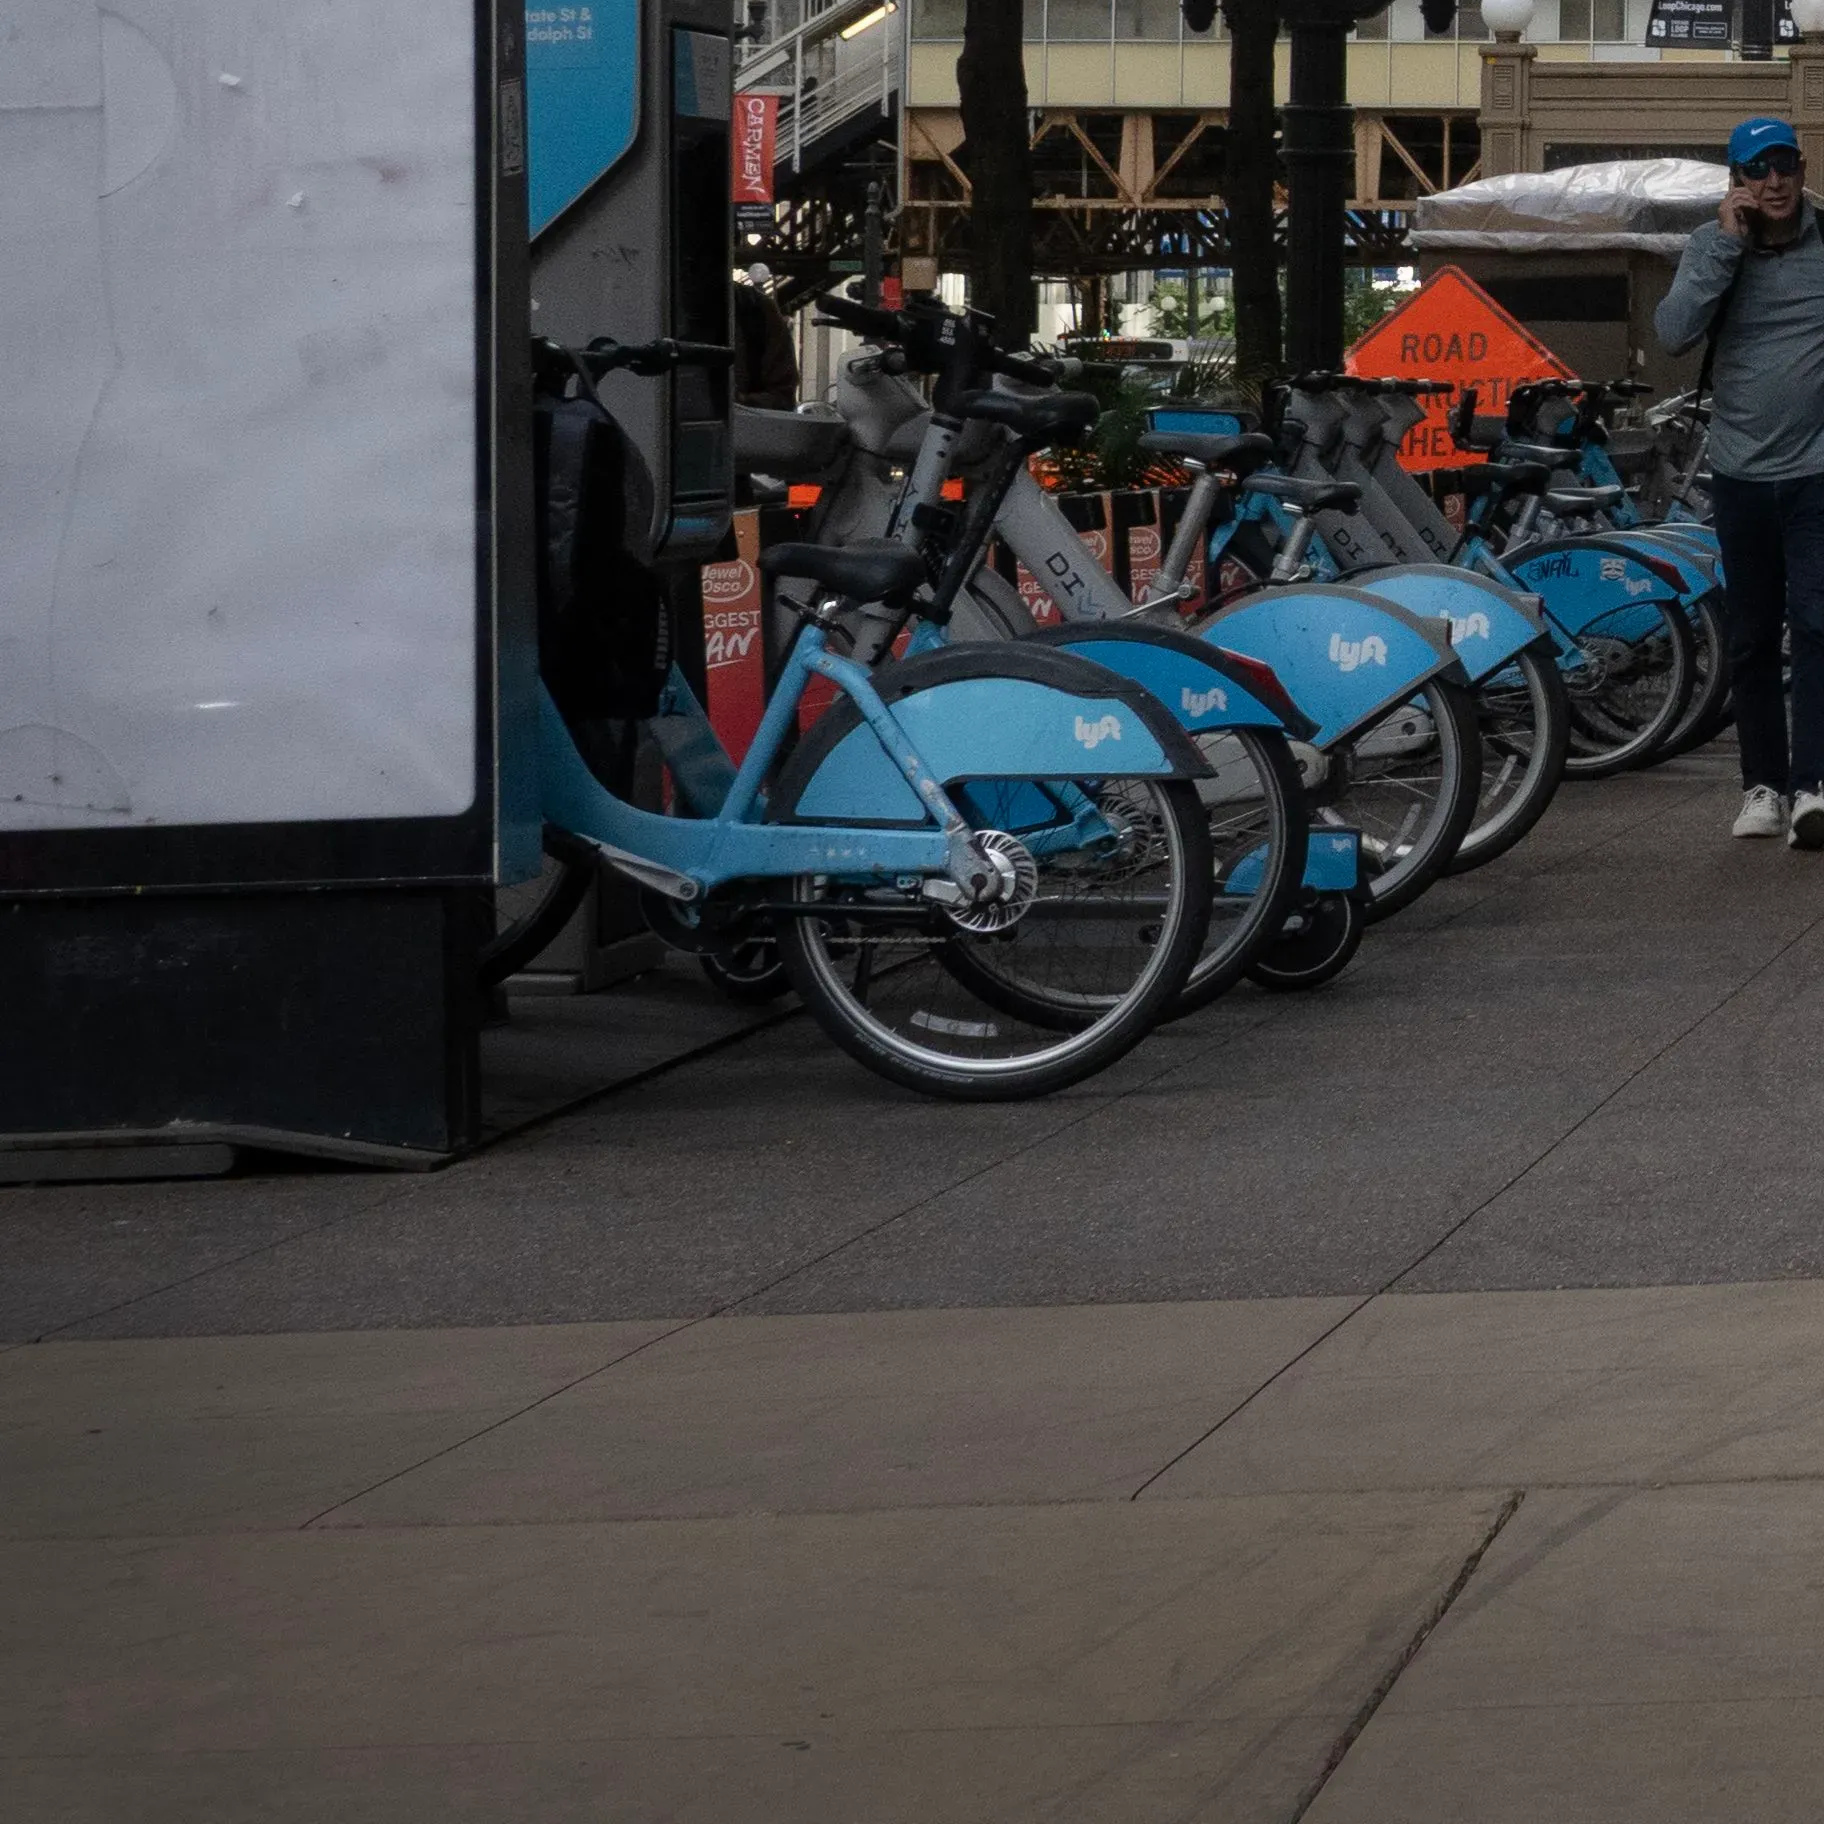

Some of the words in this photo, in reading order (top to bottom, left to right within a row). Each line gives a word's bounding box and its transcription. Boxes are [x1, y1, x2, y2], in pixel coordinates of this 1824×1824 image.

[1658, 1, 1723, 14] LoopChicago.com
[741, 97, 767, 194] CARMEN
[1400, 332, 1489, 365] ROAD
[1440, 608, 1491, 646] yft
[705, 627, 760, 663] AN
[1329, 632, 1389, 673] lyft
[1181, 687, 1228, 718] lyft
[1074, 715, 1122, 750] lyft
